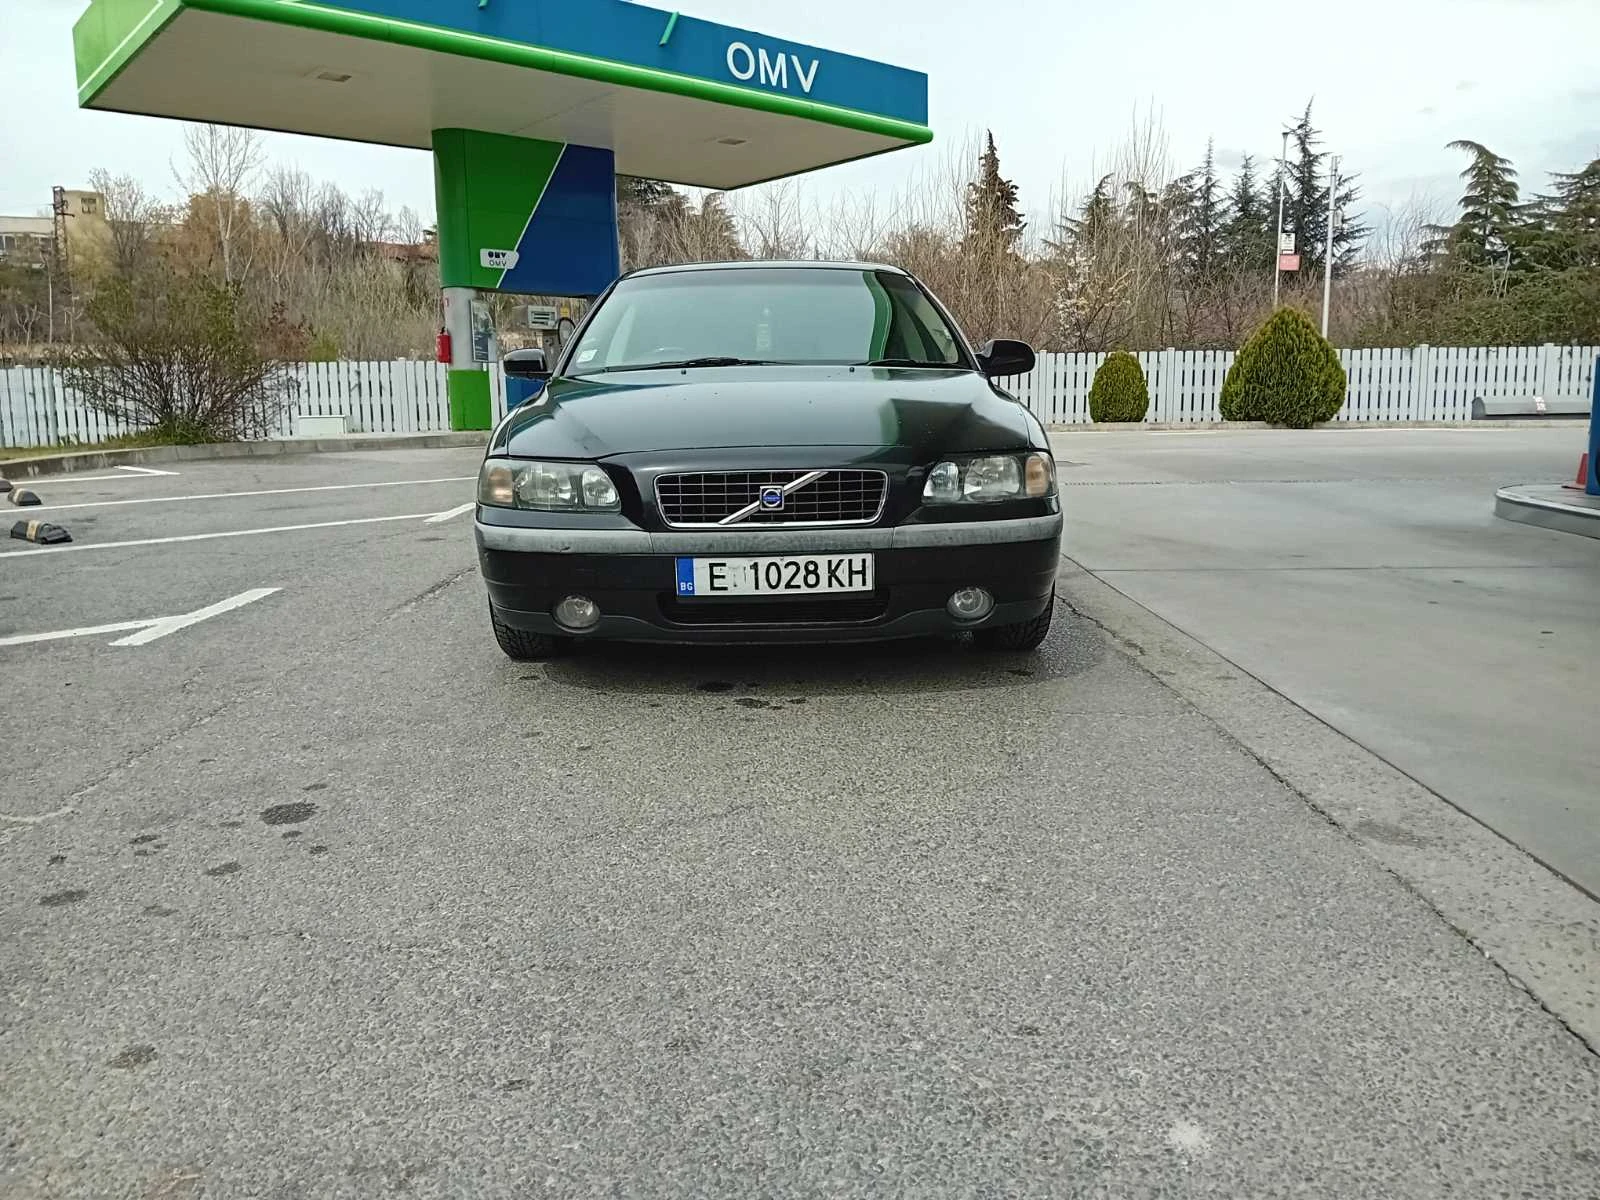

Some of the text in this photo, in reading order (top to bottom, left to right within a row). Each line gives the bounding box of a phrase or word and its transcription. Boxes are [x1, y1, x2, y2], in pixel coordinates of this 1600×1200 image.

[726, 41, 819, 93] OMV
[680, 581, 694, 591] BG
[708, 558, 867, 592] E 1028 KH
